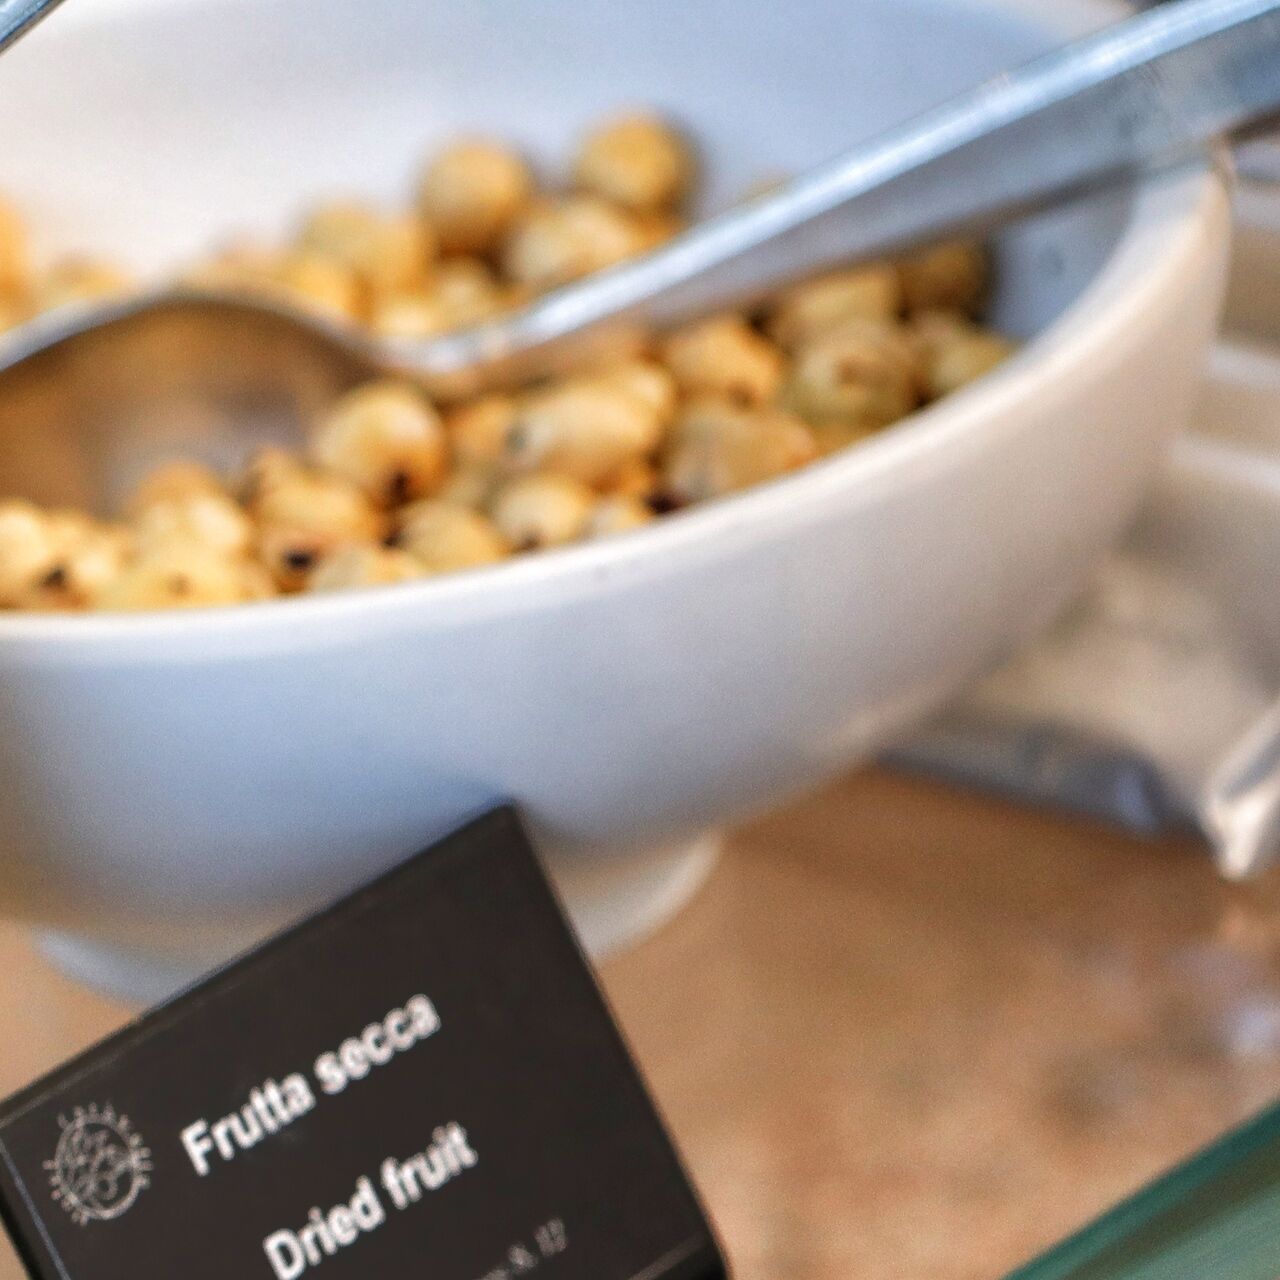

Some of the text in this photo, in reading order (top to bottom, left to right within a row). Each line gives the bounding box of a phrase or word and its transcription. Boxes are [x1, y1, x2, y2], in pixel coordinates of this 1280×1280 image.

[180, 1072, 316, 1176] Frutta
[314, 993, 441, 1095] secca
[380, 1121, 478, 1210] fruit
